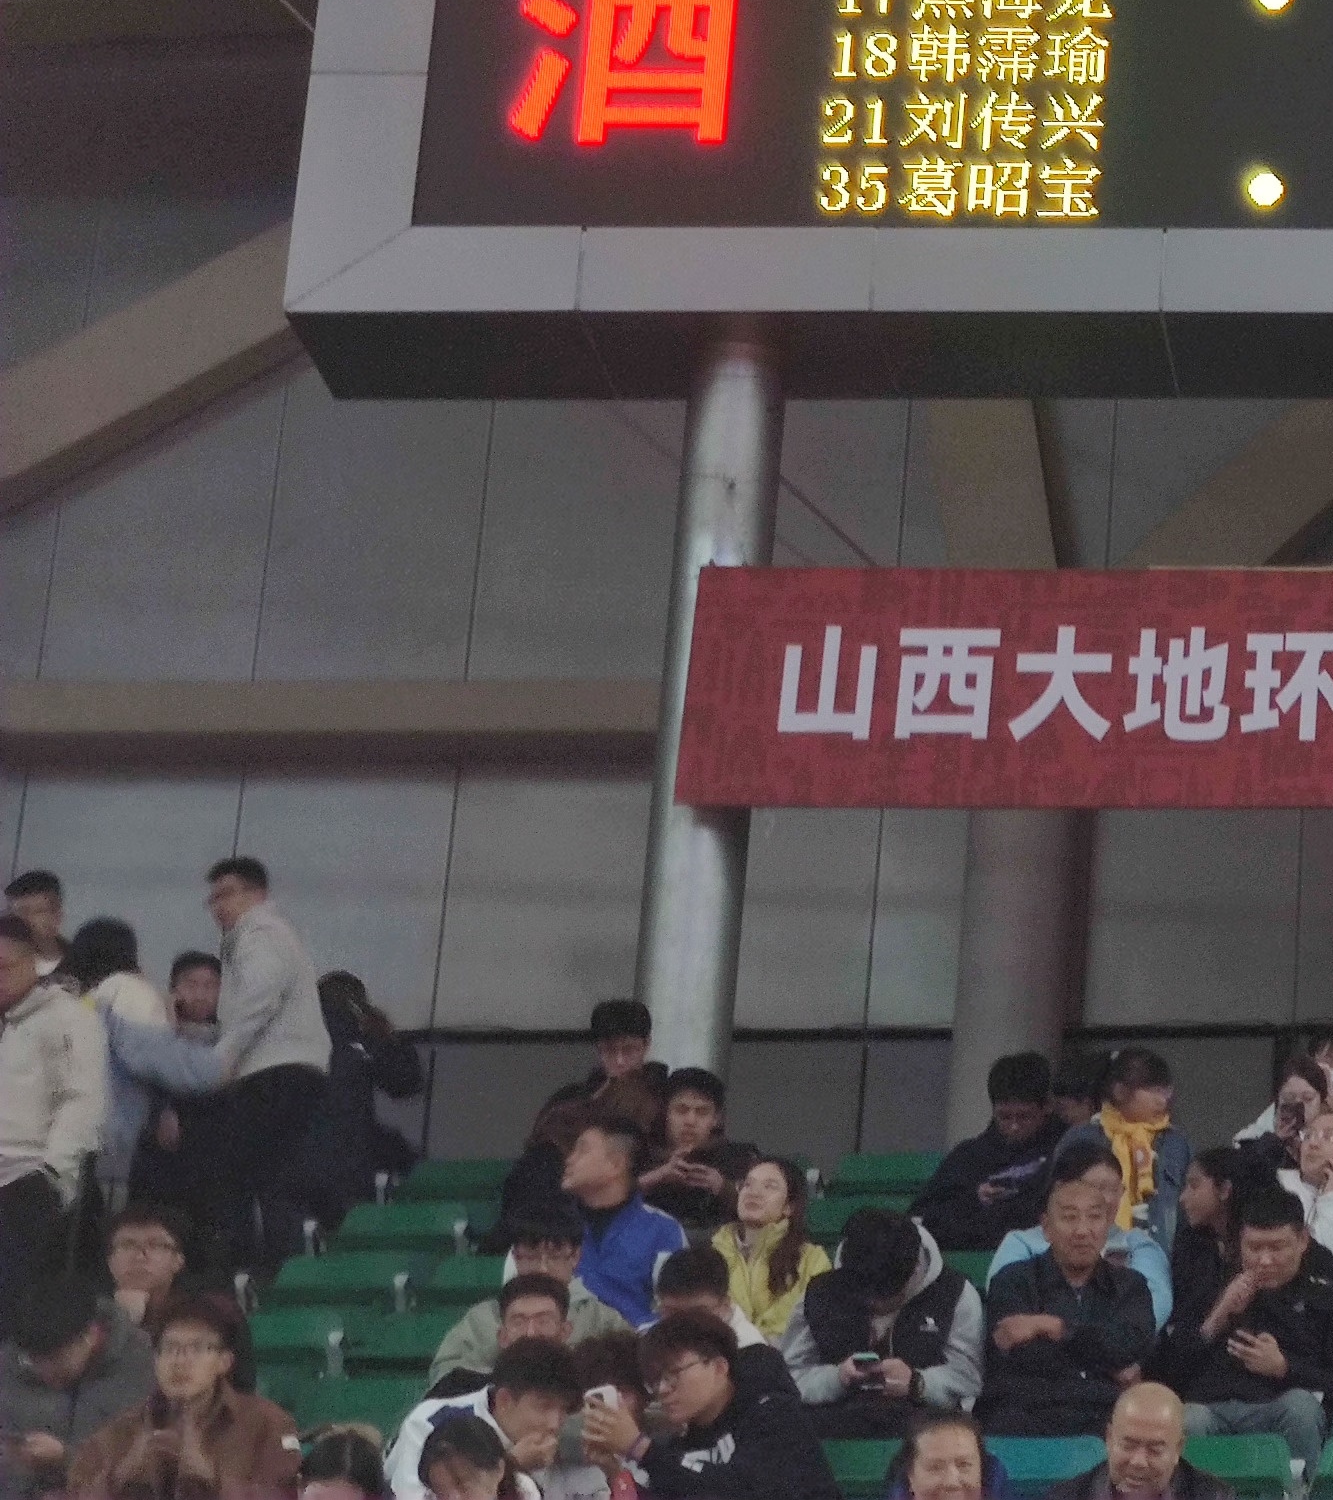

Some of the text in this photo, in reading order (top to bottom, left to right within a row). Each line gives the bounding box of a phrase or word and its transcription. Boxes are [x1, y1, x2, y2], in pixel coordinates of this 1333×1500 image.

[832, 30, 899, 79] 18
[821, 89, 1106, 153] 21 刘传兴
[819, 154, 1103, 218] 35 葛昭宝
